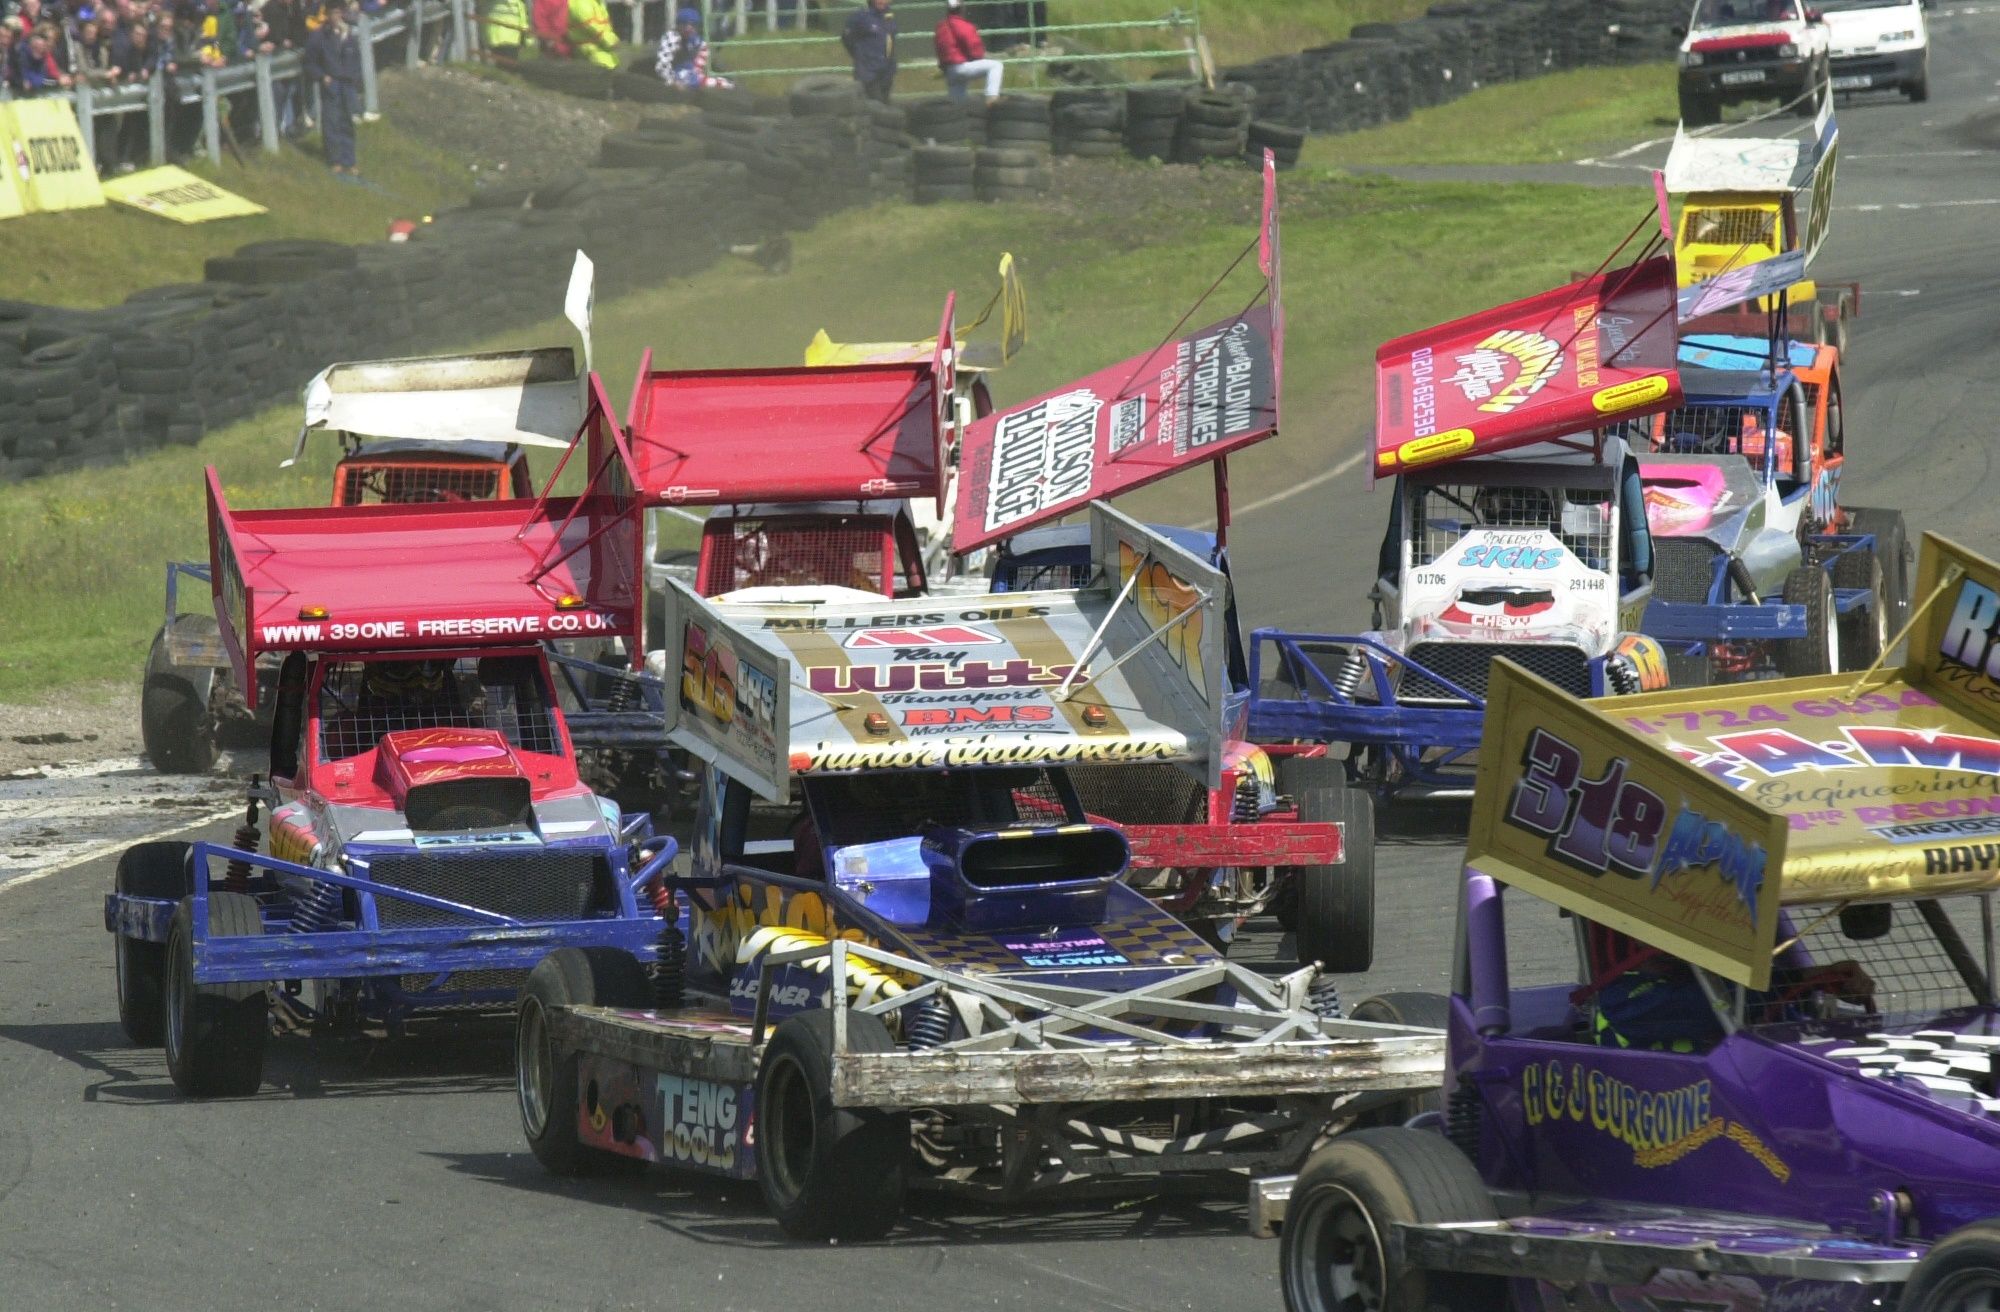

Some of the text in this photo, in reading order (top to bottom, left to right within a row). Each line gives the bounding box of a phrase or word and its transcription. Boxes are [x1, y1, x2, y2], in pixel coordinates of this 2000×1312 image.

[1192, 333, 1224, 446] MOTORHOMES
[1224, 360, 1251, 434] BALDWIN
[994, 401, 1048, 524] HAULAGE
[1049, 405, 1095, 502] WILSON
[1458, 545, 1563, 569] SIGNS
[1417, 574, 1446, 585] 01706
[262, 624, 325, 643] WWW.
[585, 612, 617, 631] UK
[762, 606, 1051, 630] MILLERS OILS
[1471, 614, 1531, 629] CHEVY
[1940, 577, 2000, 686] R
[892, 648, 970, 667] Ray
[880, 687, 1042, 706] Transport
[899, 705, 1056, 726] BMS
[1505, 727, 1668, 879] 318
[1756, 771, 2000, 809] Engineering
[1005, 938, 1106, 951] INJECTION
[1023, 955, 1129, 966] BLOWN
[657, 1071, 738, 1131] TENG
[1523, 1062, 1543, 1126] H
[1588, 1069, 1713, 1152] BURGOYNE
